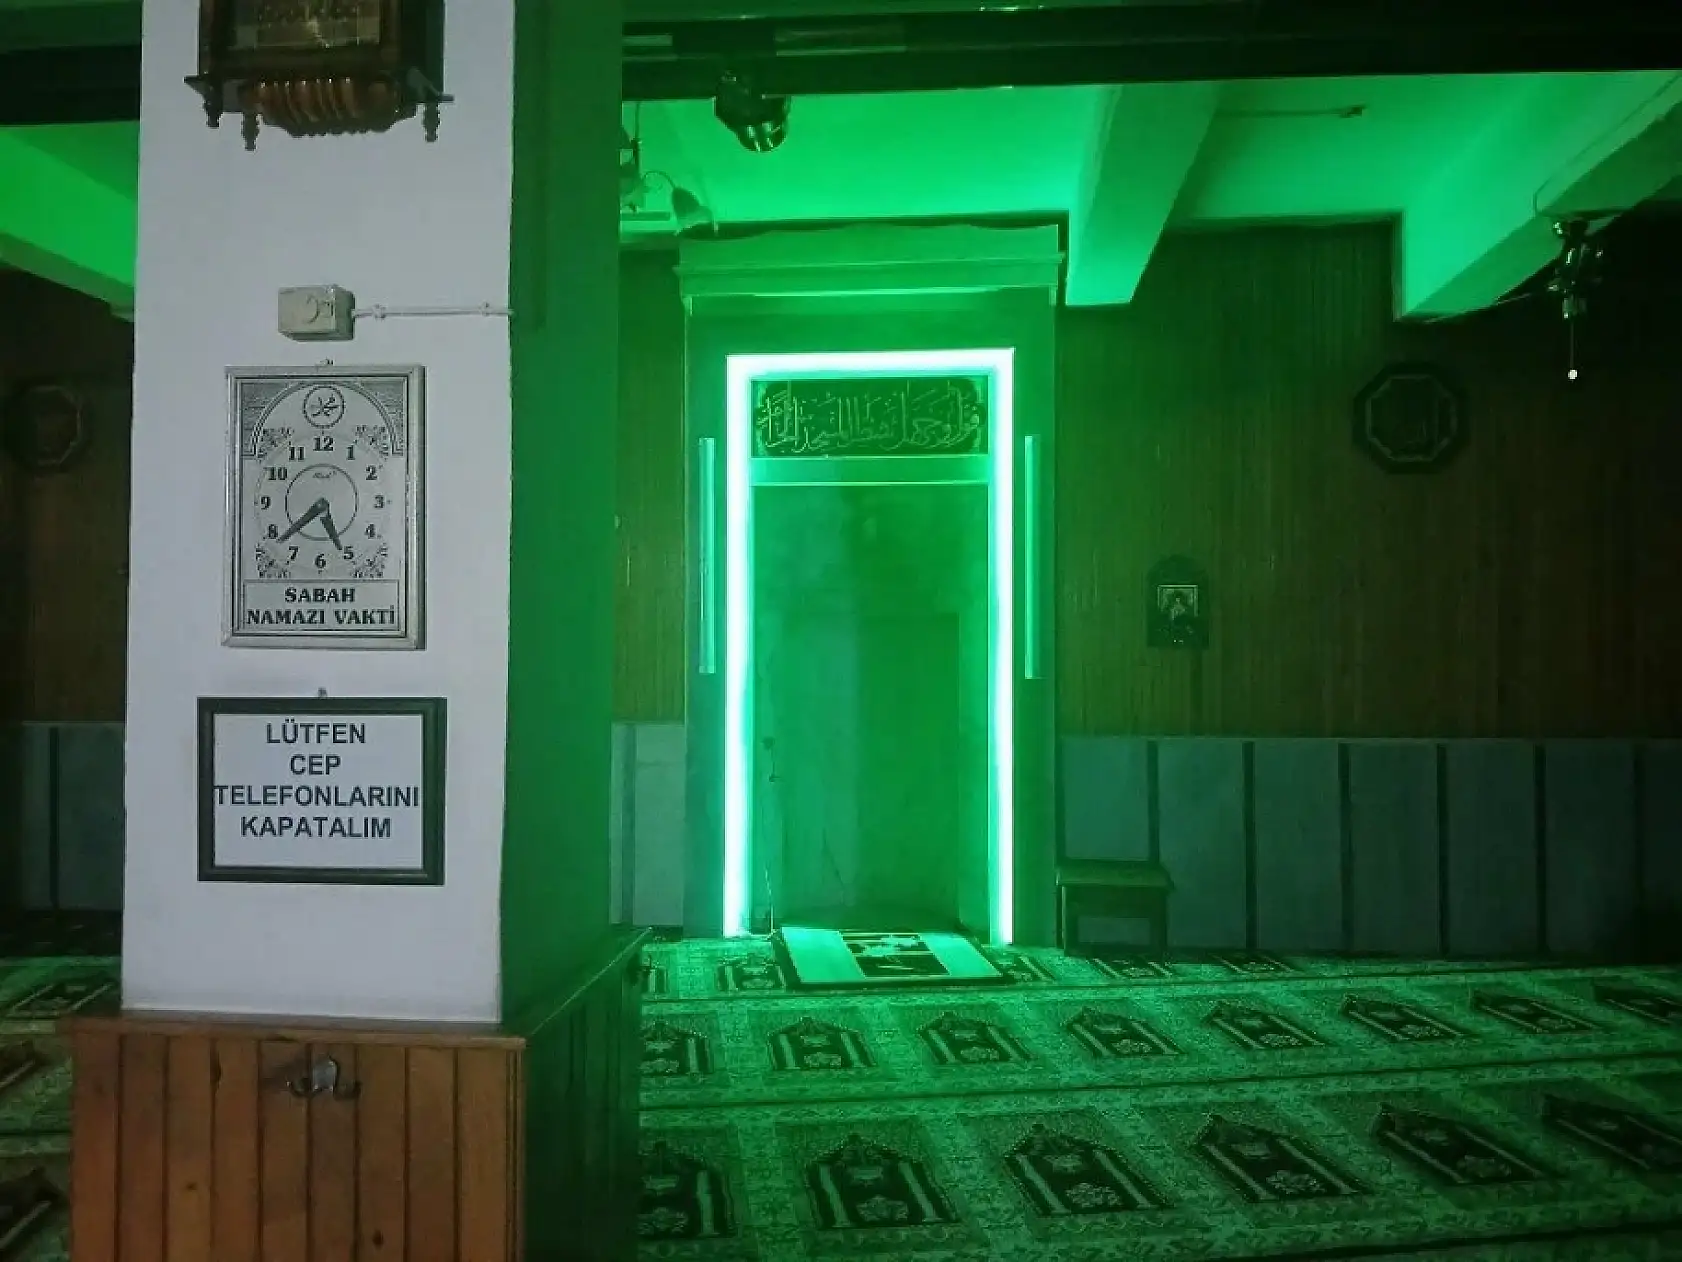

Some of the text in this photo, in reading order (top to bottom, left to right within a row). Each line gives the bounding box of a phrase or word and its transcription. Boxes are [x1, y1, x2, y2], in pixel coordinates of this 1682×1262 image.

[313, 436, 334, 452] 12
[288, 446, 305, 461] 11
[346, 445, 356, 461] 1
[268, 466, 288, 481] 10
[365, 465, 378, 481] 2
[260, 496, 271, 510] 9
[374, 496, 385, 509] 3
[267, 524, 279, 540] 8
[365, 524, 376, 539] 4
[288, 546, 300, 562] 7
[315, 553, 327, 569] 6
[343, 546, 354, 561] 5
[284, 588, 356, 603] SABAH
[246, 605, 395, 625] NAMAZI VAKTİ
[266, 718, 366, 744] LÜTFEN
[290, 754, 341, 776] CEP
[213, 785, 419, 807] TELEFONLARINI
[240, 816, 391, 838] KAPATALIM
